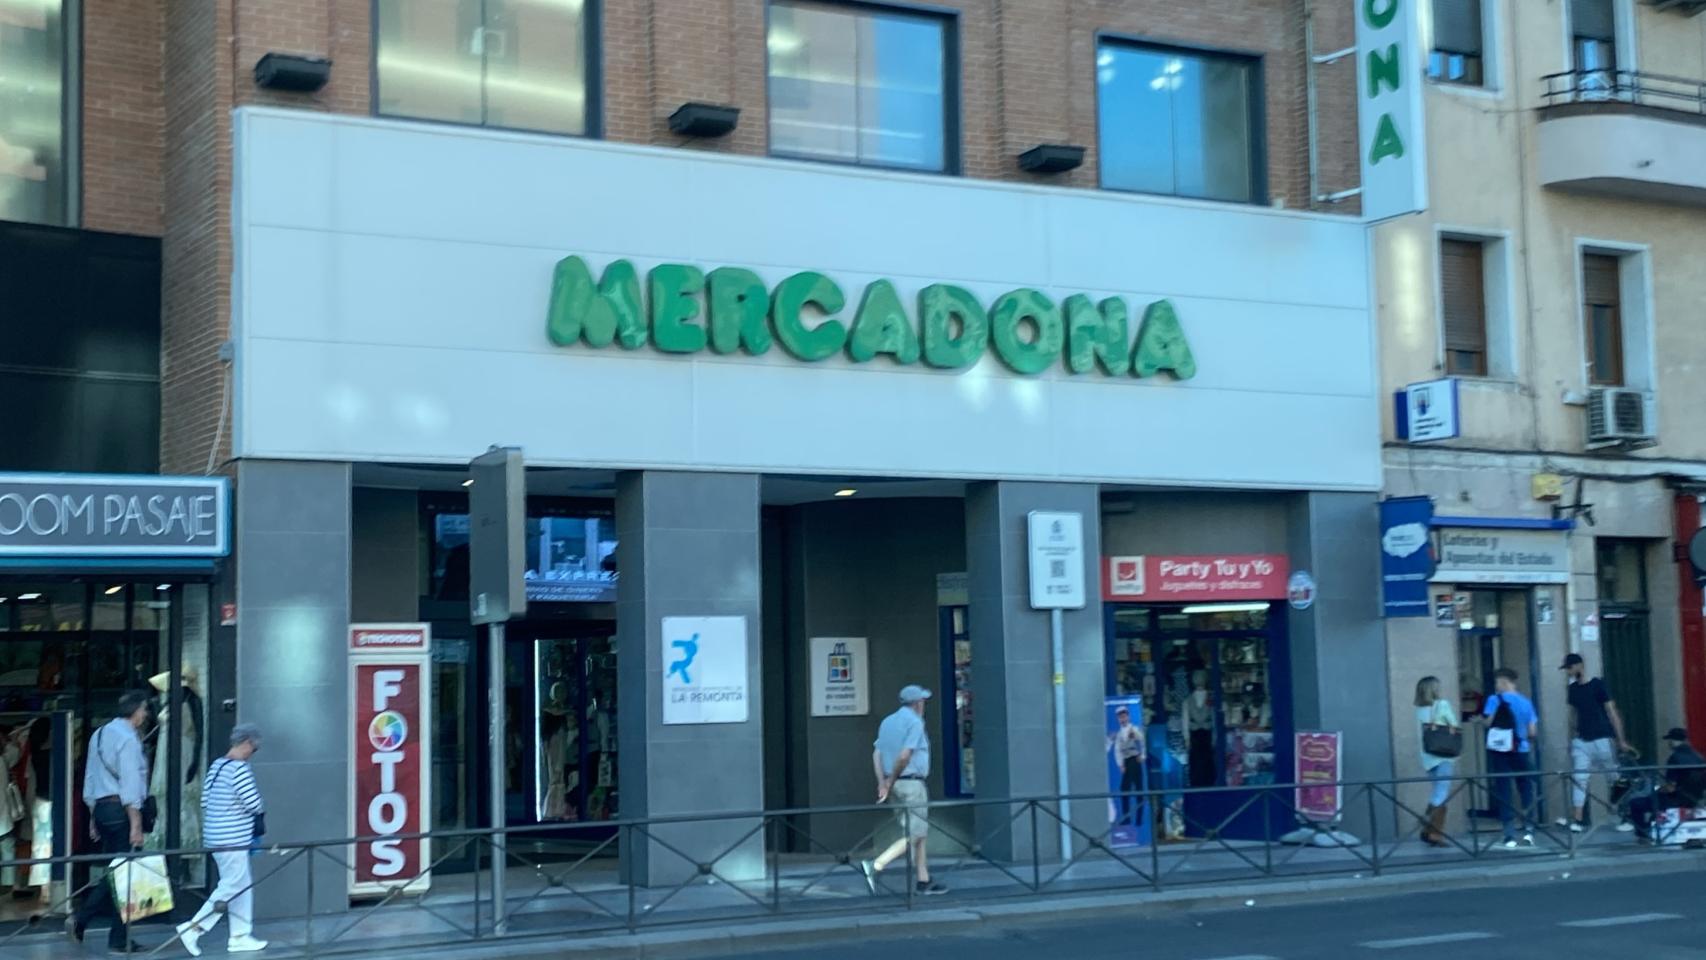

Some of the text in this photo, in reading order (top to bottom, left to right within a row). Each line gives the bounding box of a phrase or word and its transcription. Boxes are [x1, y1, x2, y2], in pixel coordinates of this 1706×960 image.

[547, 254, 1197, 380] MERCADONA
[0, 493, 215, 542] OOM PASAJE
[1160, 559, 1274, 580] Party Tu y Yo
[367, 669, 409, 877] FOTOS
